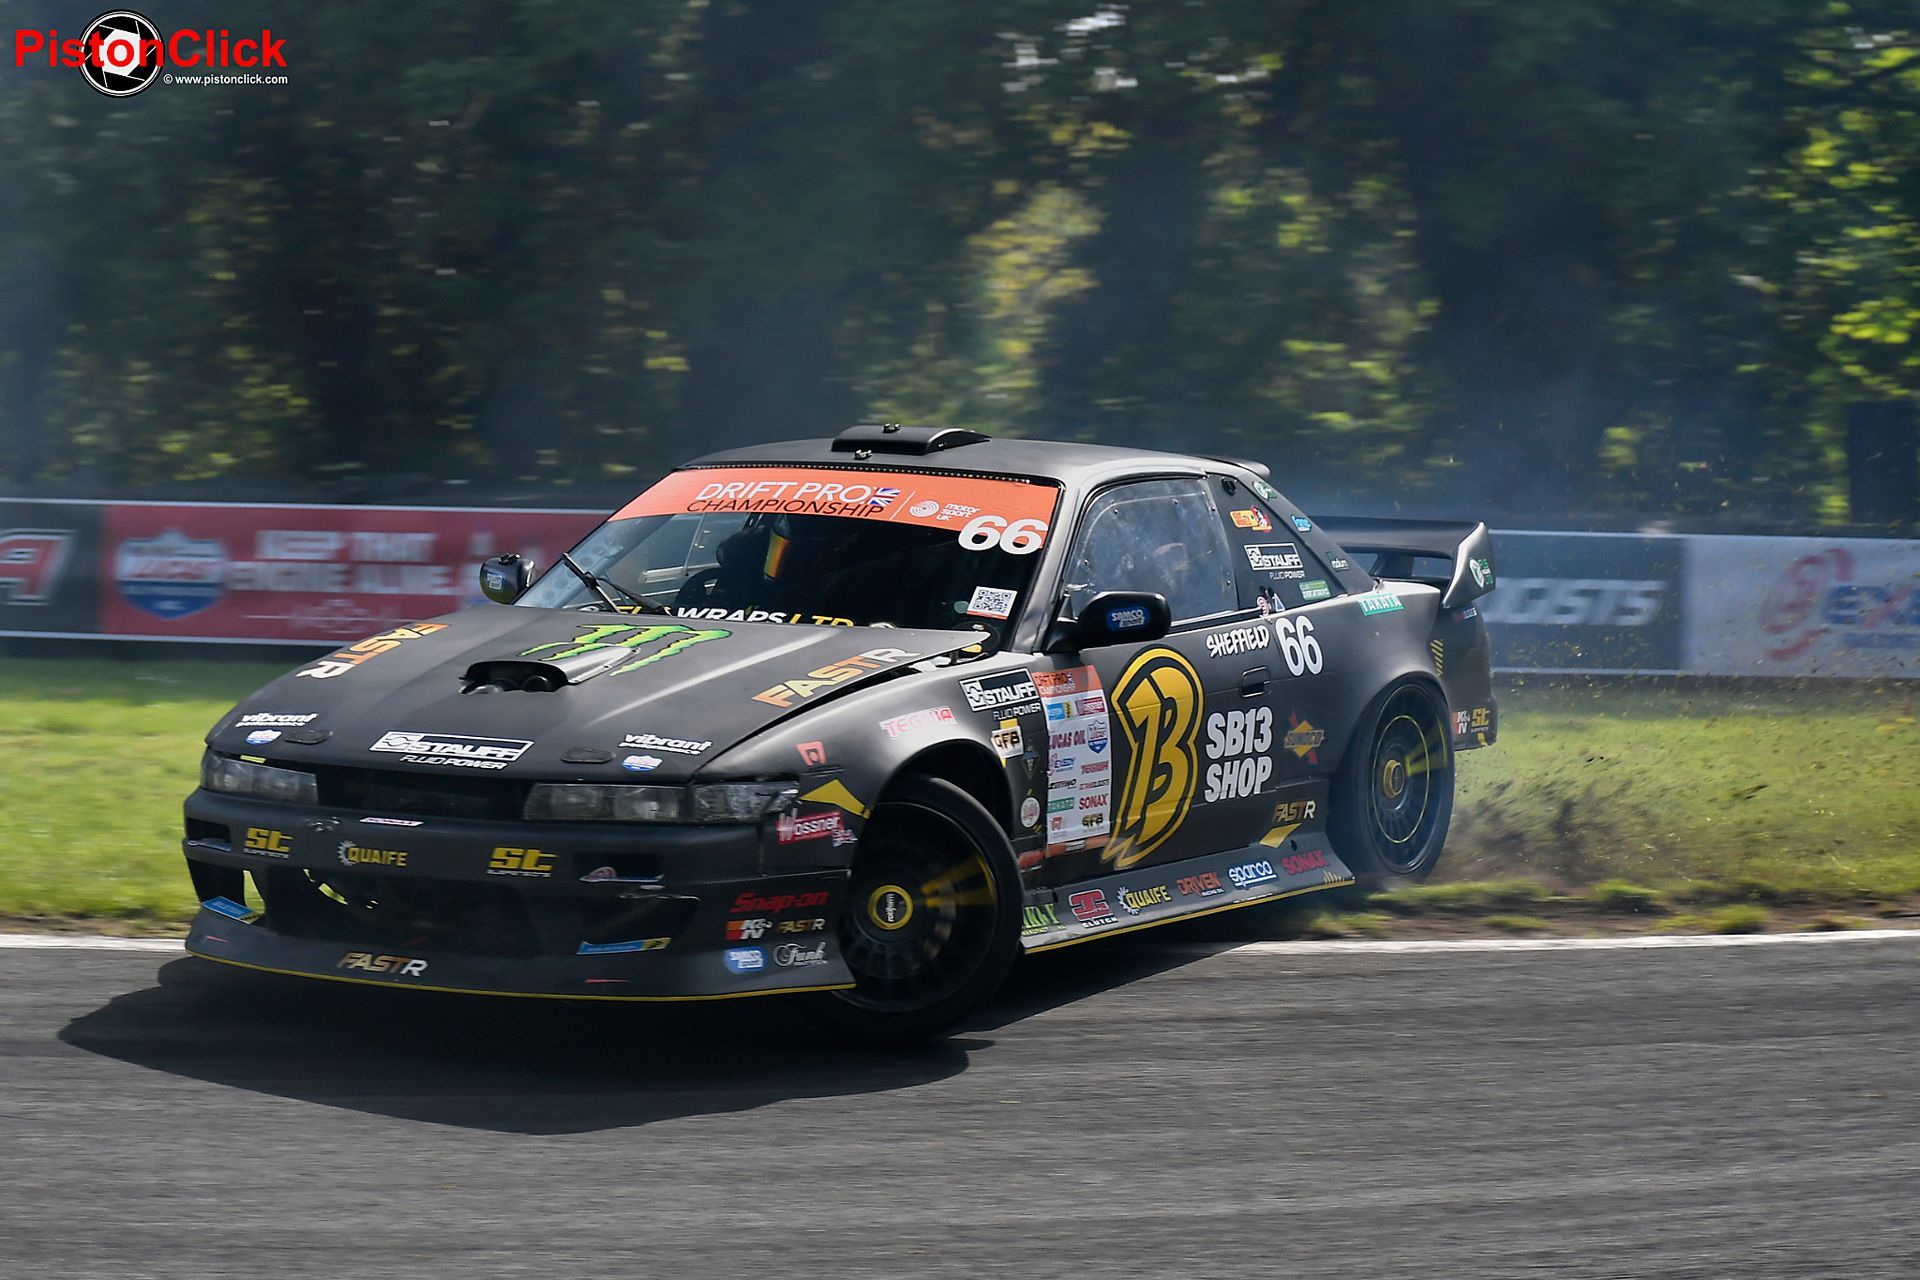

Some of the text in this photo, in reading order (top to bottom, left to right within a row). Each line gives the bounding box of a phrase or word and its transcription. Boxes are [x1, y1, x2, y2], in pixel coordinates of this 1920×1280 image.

[696, 481, 872, 504] DRIFT PRO
[687, 499, 885, 518] CHAMPIONSHIP
[958, 515, 1049, 555] 66
[1263, 555, 1301, 566] STAUFF
[1359, 594, 1403, 613] TAKATA
[677, 607, 787, 624] WRAPS
[1206, 625, 1270, 658] SHEFFIELD
[1275, 615, 1324, 677] 66
[985, 683, 1039, 703] STAUFF
[242, 713, 318, 723] vibrant
[1013, 702, 1041, 717] POWER
[625, 734, 713, 751] vibrant
[1206, 706, 1274, 761] SB13
[405, 742, 514, 758] STAUFF
[400, 754, 508, 770] FLUID POWER
[1204, 756, 1273, 803] SHOP
[1079, 794, 1109, 811] SONAX
[350, 847, 408, 866] QUAIFE
[1282, 850, 1328, 875] SONAX
[1228, 860, 1277, 886] sparco
[1177, 871, 1222, 896] DRIVEN
[730, 891, 830, 914] Snap-on
[1125, 885, 1172, 909] QUAIFE
[1082, 917, 1118, 928] CLUTCH
